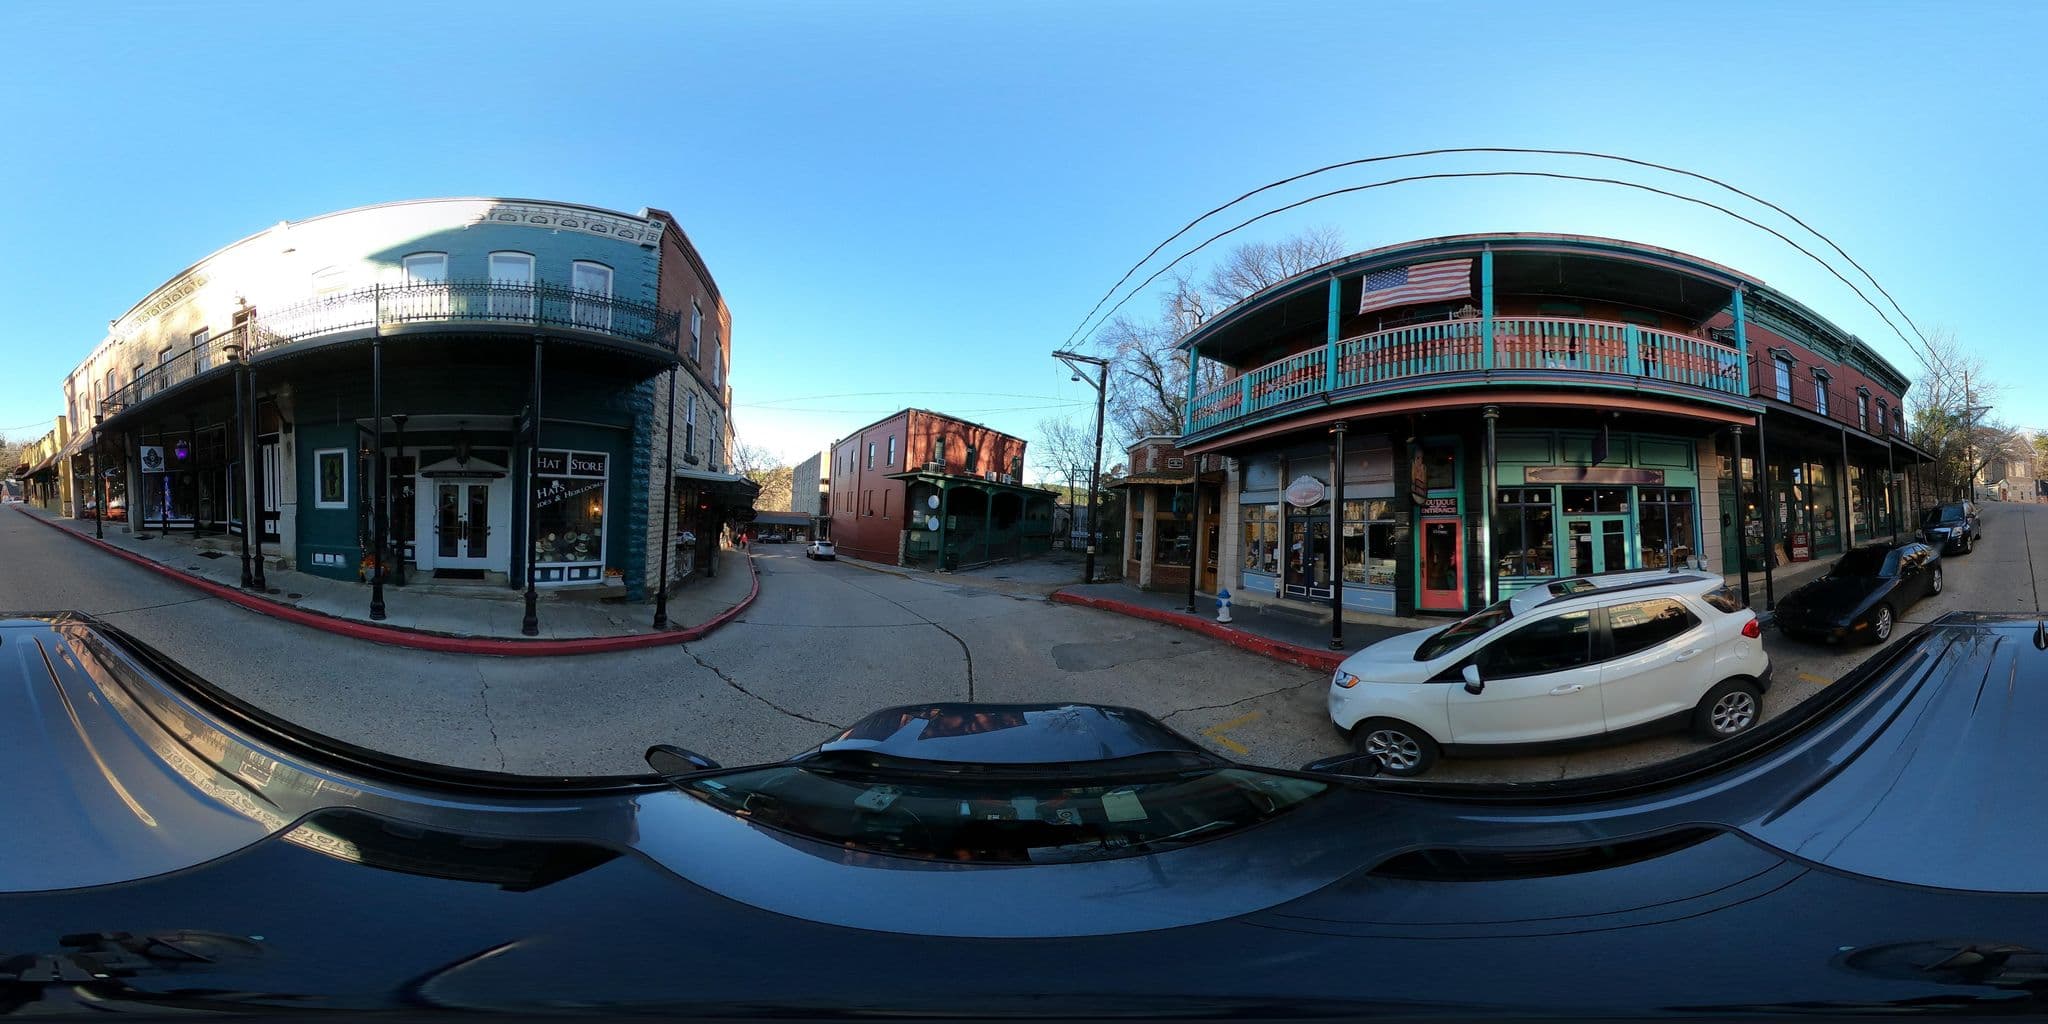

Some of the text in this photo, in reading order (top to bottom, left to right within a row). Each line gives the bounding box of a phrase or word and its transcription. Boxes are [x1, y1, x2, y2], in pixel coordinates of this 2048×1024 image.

[537, 457, 604, 472] HAT STORE
[537, 484, 565, 499] HATS
